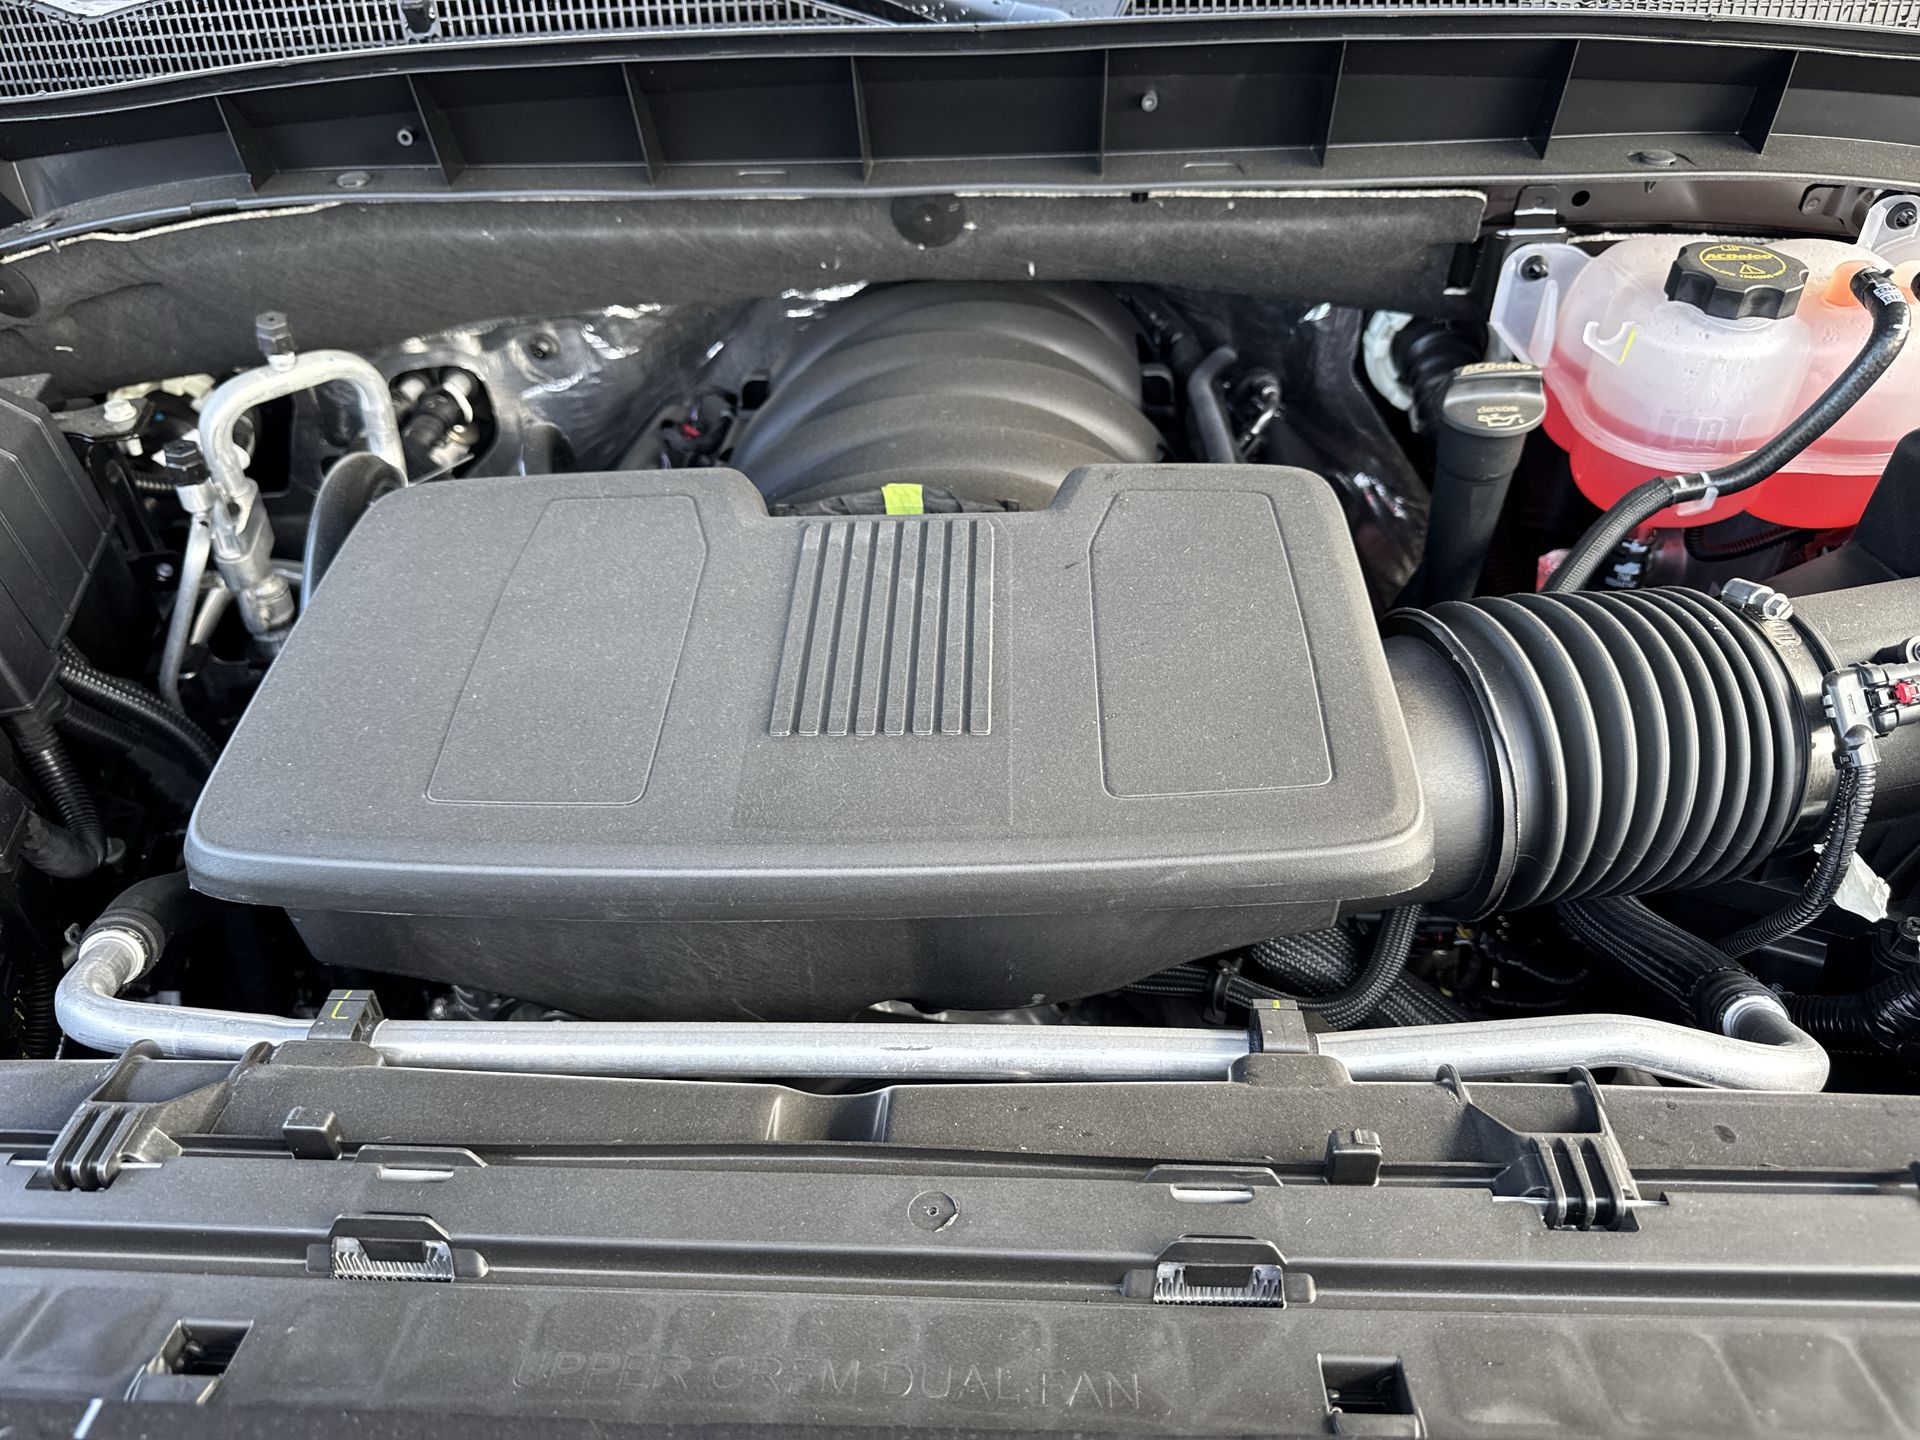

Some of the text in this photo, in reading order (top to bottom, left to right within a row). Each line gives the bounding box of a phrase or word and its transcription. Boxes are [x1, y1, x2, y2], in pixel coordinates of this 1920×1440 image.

[1704, 252, 1773, 261] ACDelco
[1461, 362, 1533, 375] ACDelco
[512, 1350, 693, 1391] UPPER
[881, 1361, 1019, 1402] DUAL
